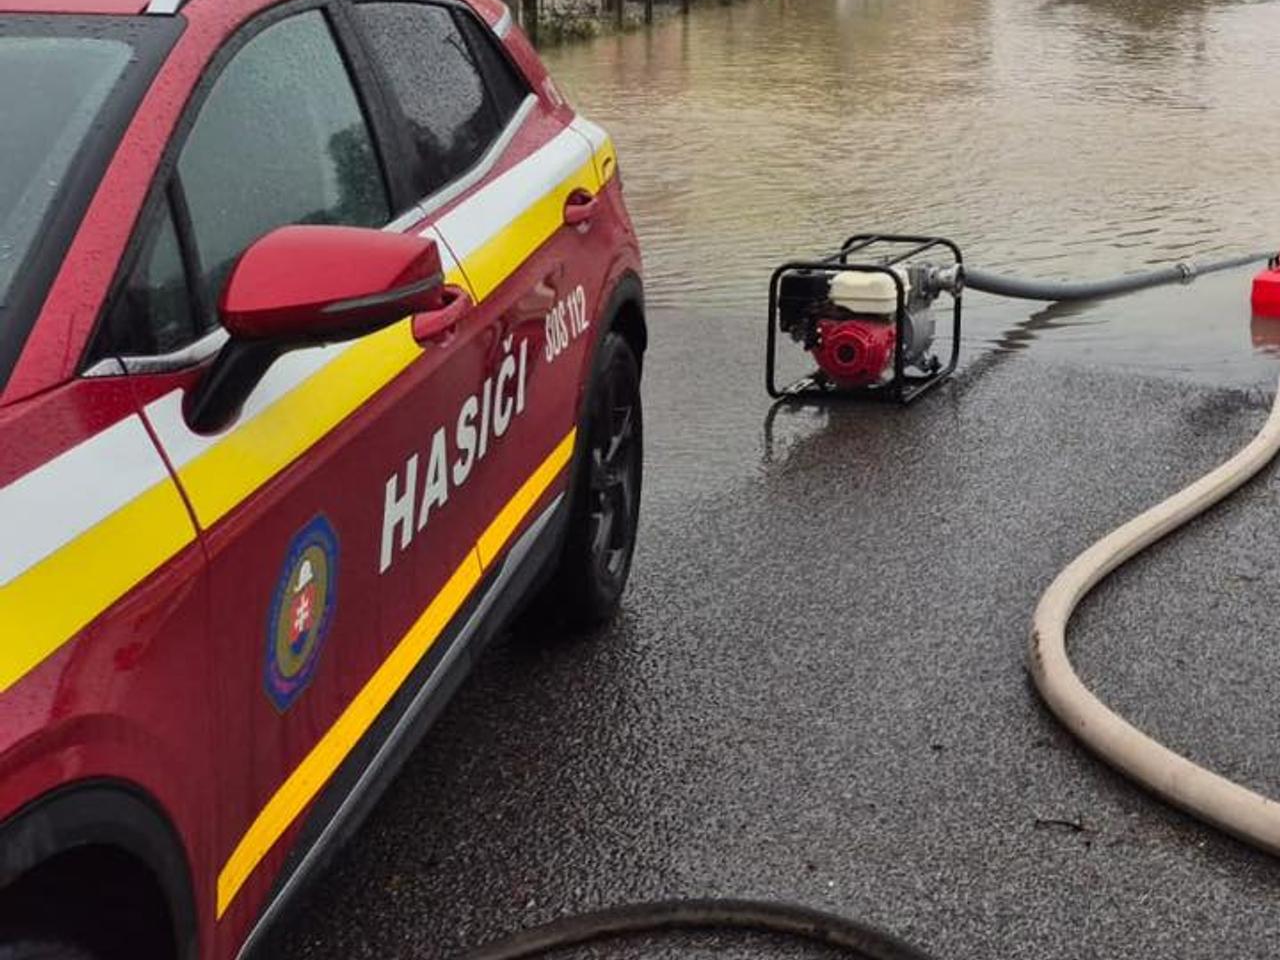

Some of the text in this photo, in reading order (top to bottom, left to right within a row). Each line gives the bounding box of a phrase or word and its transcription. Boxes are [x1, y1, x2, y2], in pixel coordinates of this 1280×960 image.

[545, 285, 590, 363] SOS 112
[380, 333, 528, 574] HASIČI
